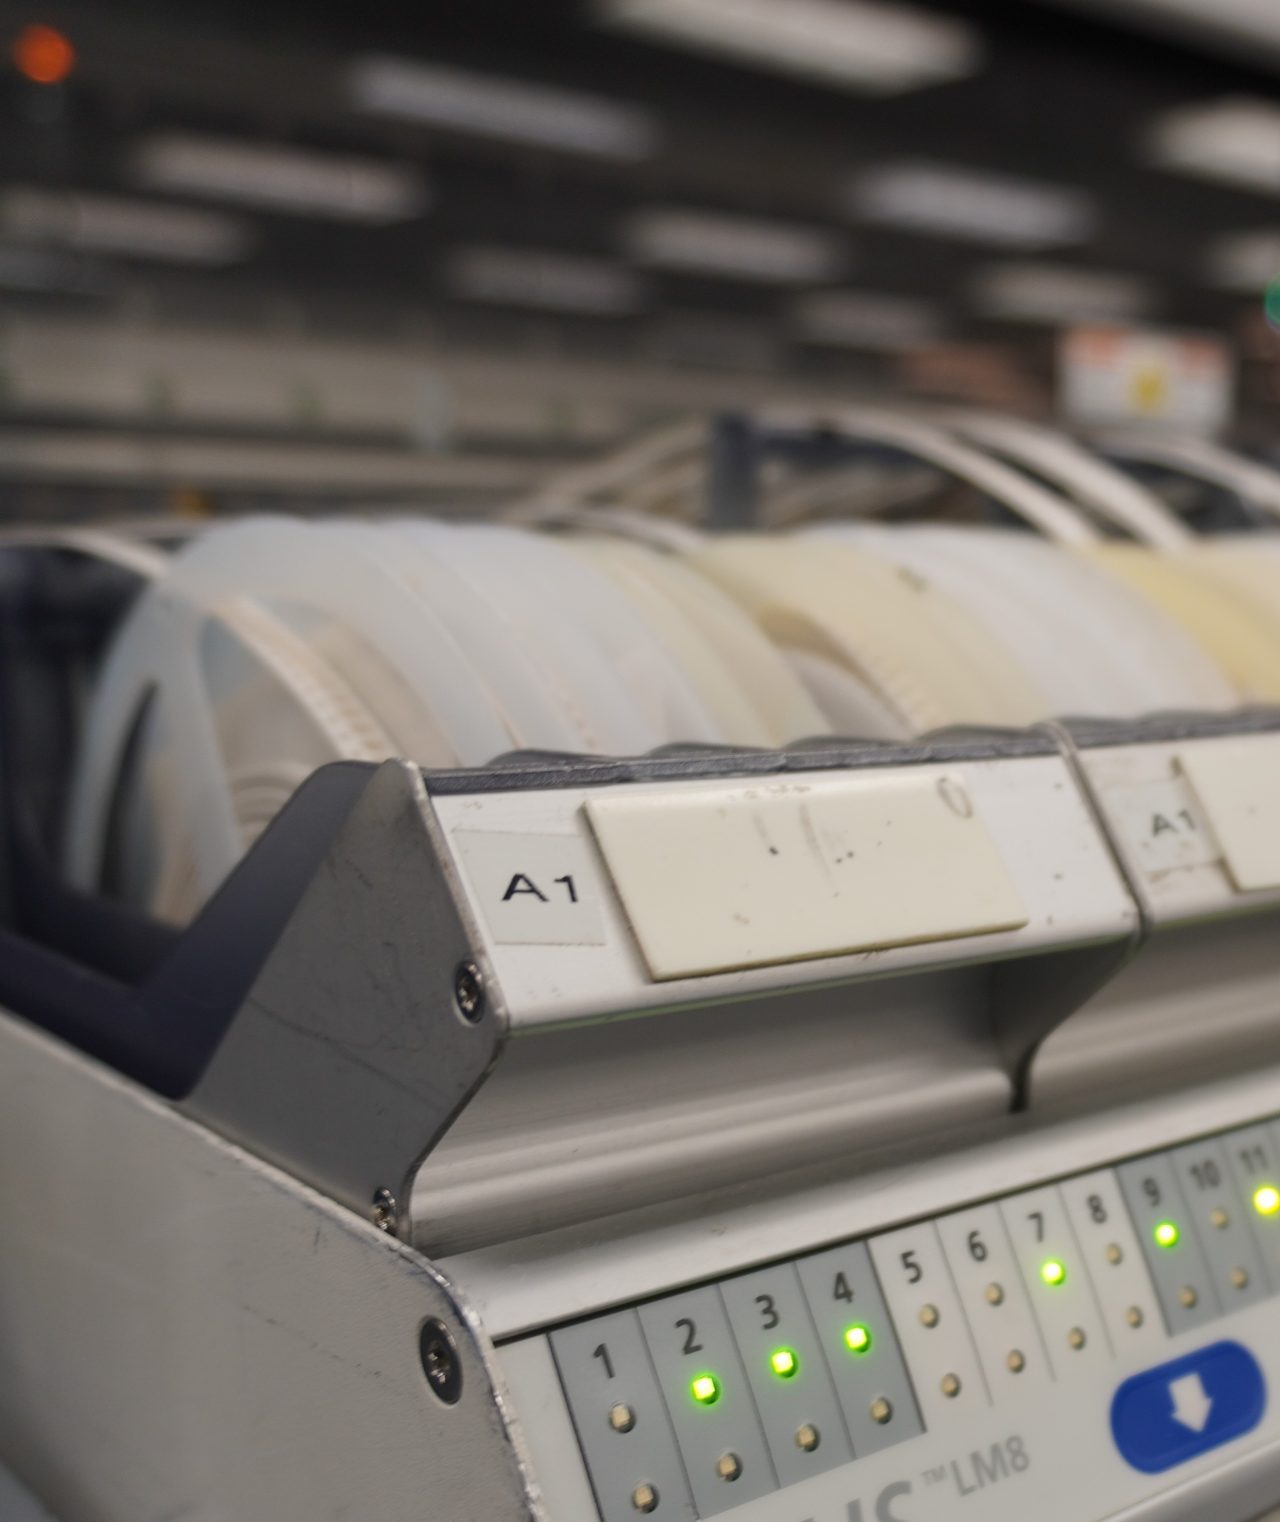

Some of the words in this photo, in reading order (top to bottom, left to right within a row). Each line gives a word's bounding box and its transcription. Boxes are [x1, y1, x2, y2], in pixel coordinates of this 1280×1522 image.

[1152, 809, 1196, 838] A1
[501, 872, 578, 903] A1
[593, 1343, 615, 1379] 1
[675, 1318, 703, 1355] 2
[755, 1294, 780, 1330] 3
[834, 1271, 854, 1304] 4
[901, 1250, 922, 1284] 5
[967, 1231, 988, 1262] 6
[1027, 1212, 1045, 1242] 7
[1087, 1194, 1107, 1225] 8
[1142, 1177, 1161, 1206] 9
[1189, 1159, 1222, 1190] 10
[1241, 1147, 1269, 1174] 11
[951, 1434, 1031, 1497] LM8
